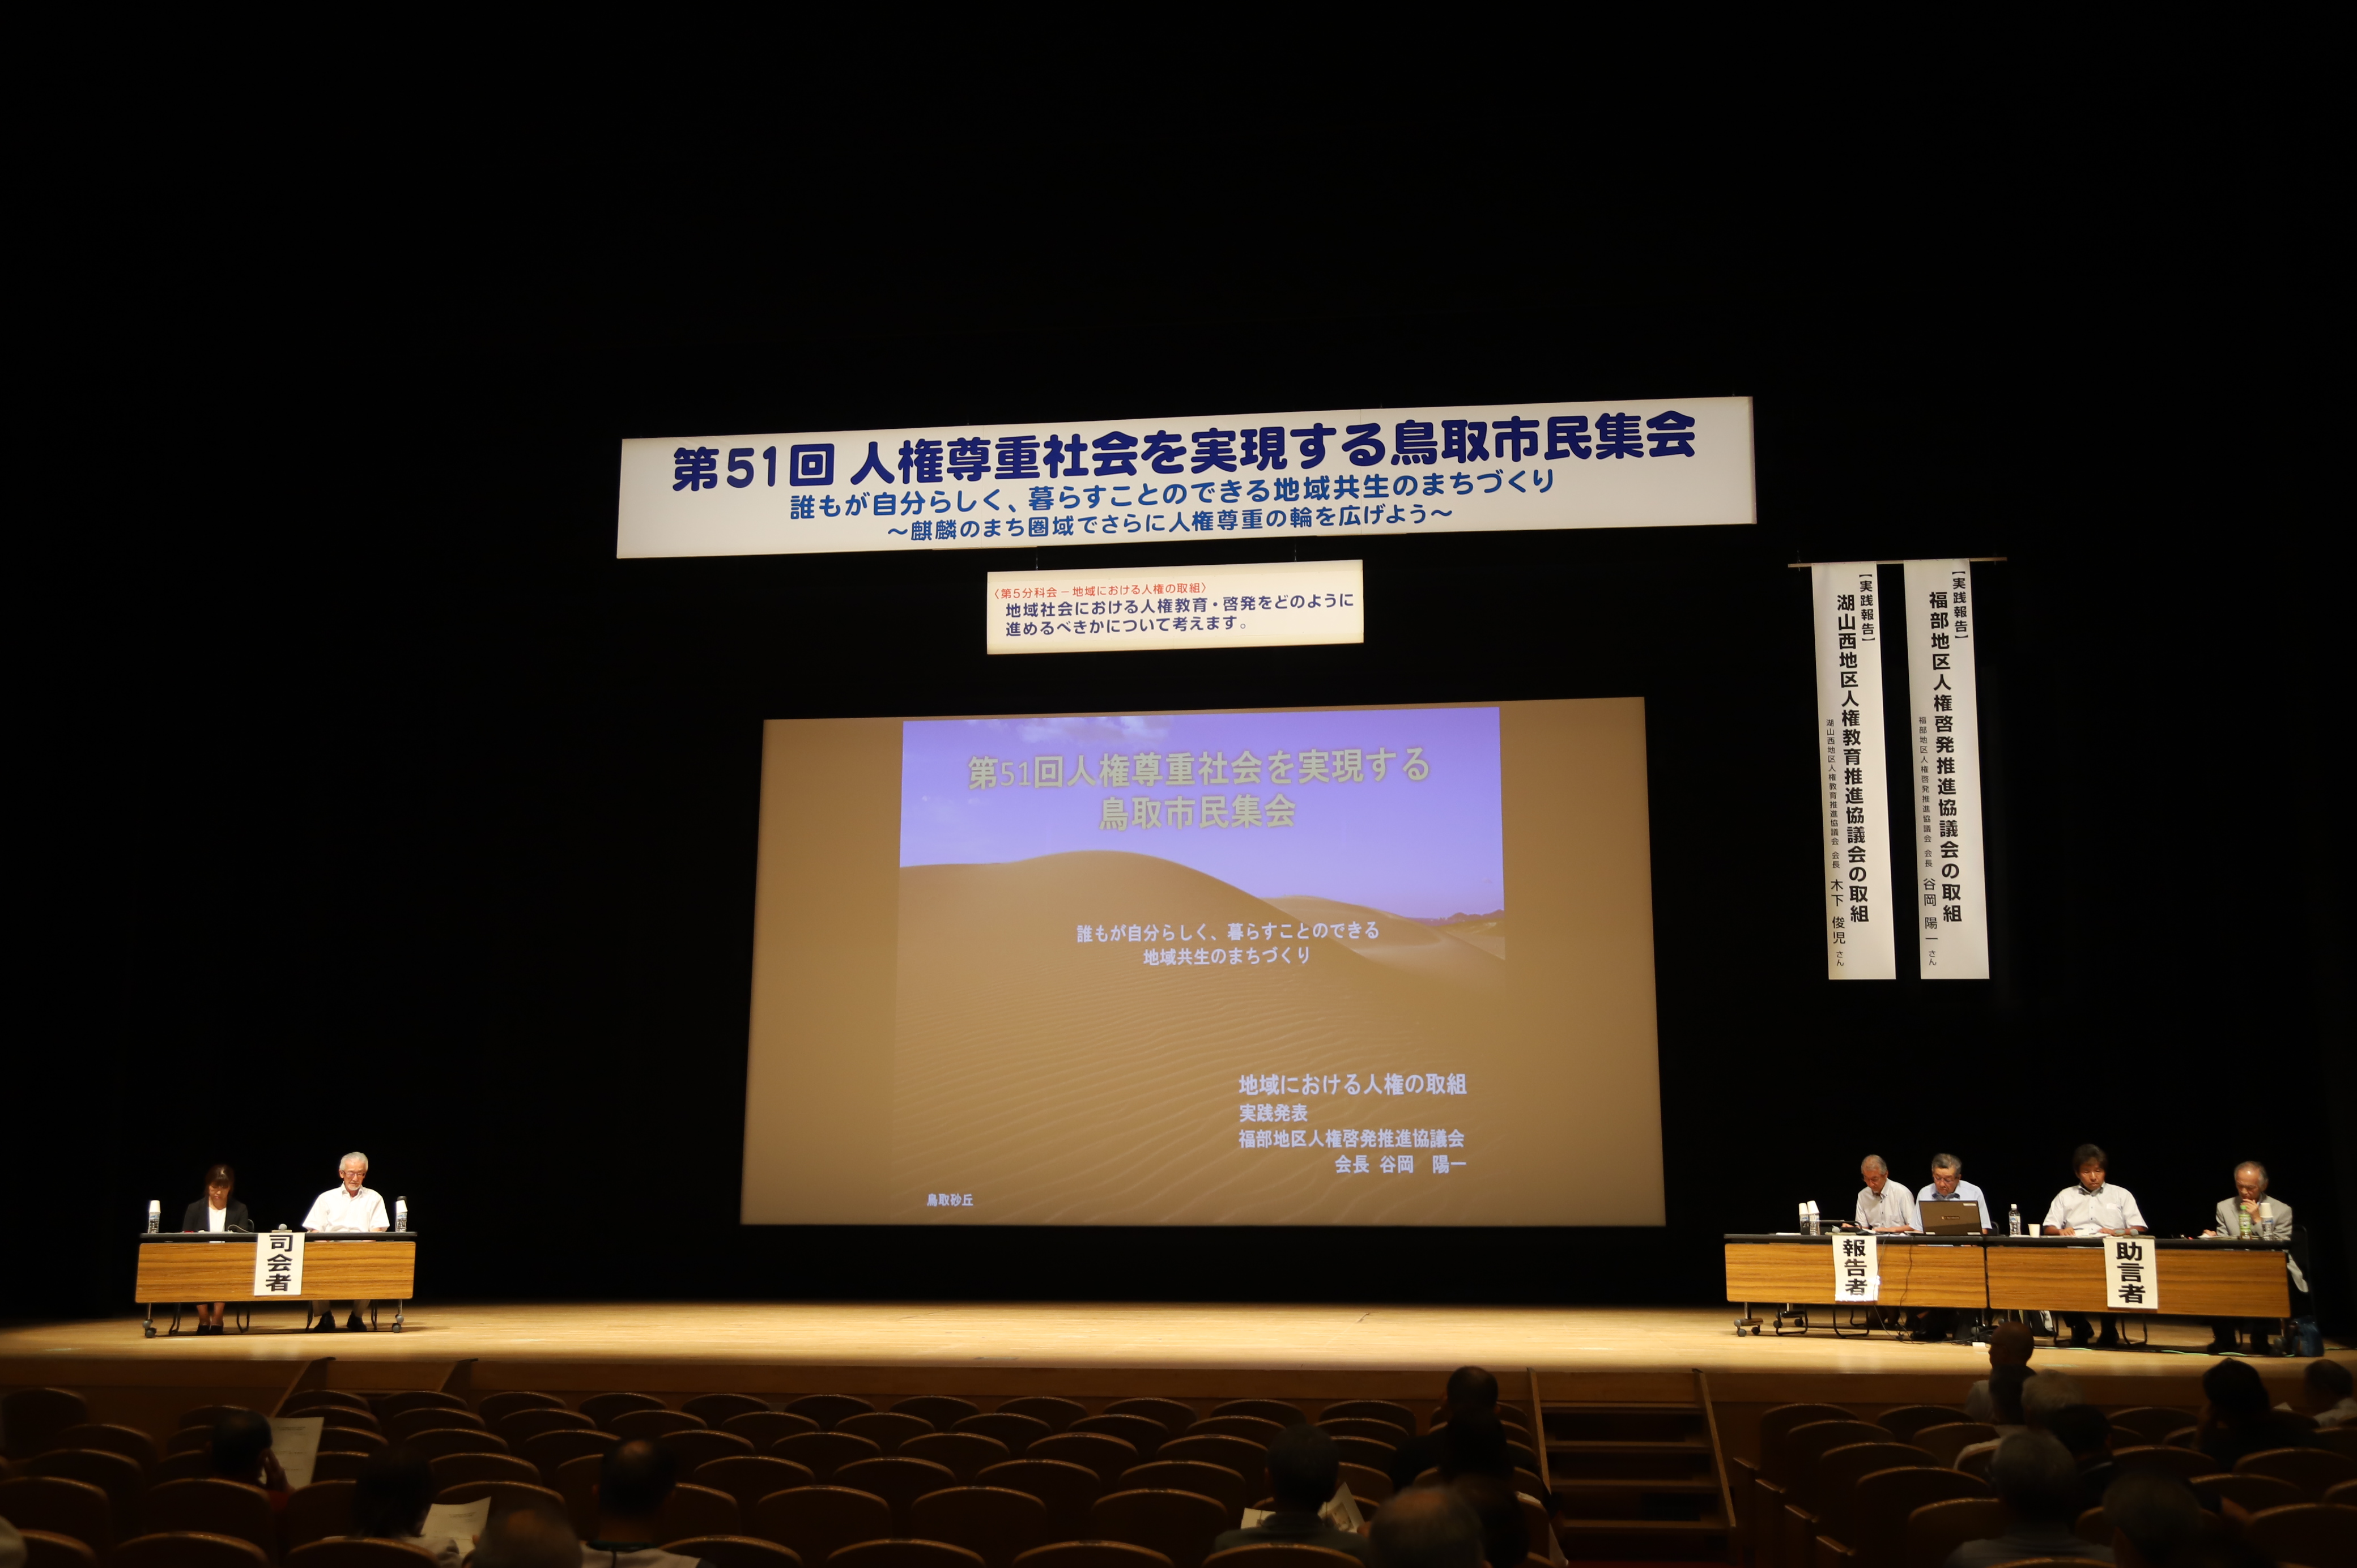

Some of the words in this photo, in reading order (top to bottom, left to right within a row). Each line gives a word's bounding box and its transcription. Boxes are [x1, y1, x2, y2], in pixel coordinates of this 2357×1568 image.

[790, 468, 1553, 520] 誰もが自分らしく、暮らすことのできる地域共生のまちづくり
[1006, 615, 1246, 637] 進めるべきかについて考えます。
[968, 747, 1430, 790] 第51回人権尊重社会を実現する
[1837, 594, 1869, 923] 湖山西地区人権教育推進協議会の取組
[1929, 591, 1962, 922] 福部地区人権啓発推進協議会の取組
[1099, 794, 1296, 832] 鳥取市民集会
[1076, 921, 1379, 943] 誰もが自分らしく、暮らすことのできる
[1143, 946, 1309, 966] 地域共生のまちづくり
[1239, 1072, 1467, 1096] 地域における人権の取組
[1239, 1103, 1308, 1123] 実践発表
[1238, 1128, 1465, 1149] 福部地区人権啓発推進協議会
[1334, 1154, 1369, 1174] 会長
[1379, 1155, 1414, 1174] 谷岡
[1432, 1154, 1467, 1174] 陽一
[926, 1193, 974, 1207] 鳥取砂丘
[265, 1234, 293, 1292] 司会者
[1843, 1239, 1867, 1295] 報告者
[2116, 1241, 2146, 1304] 助言者
